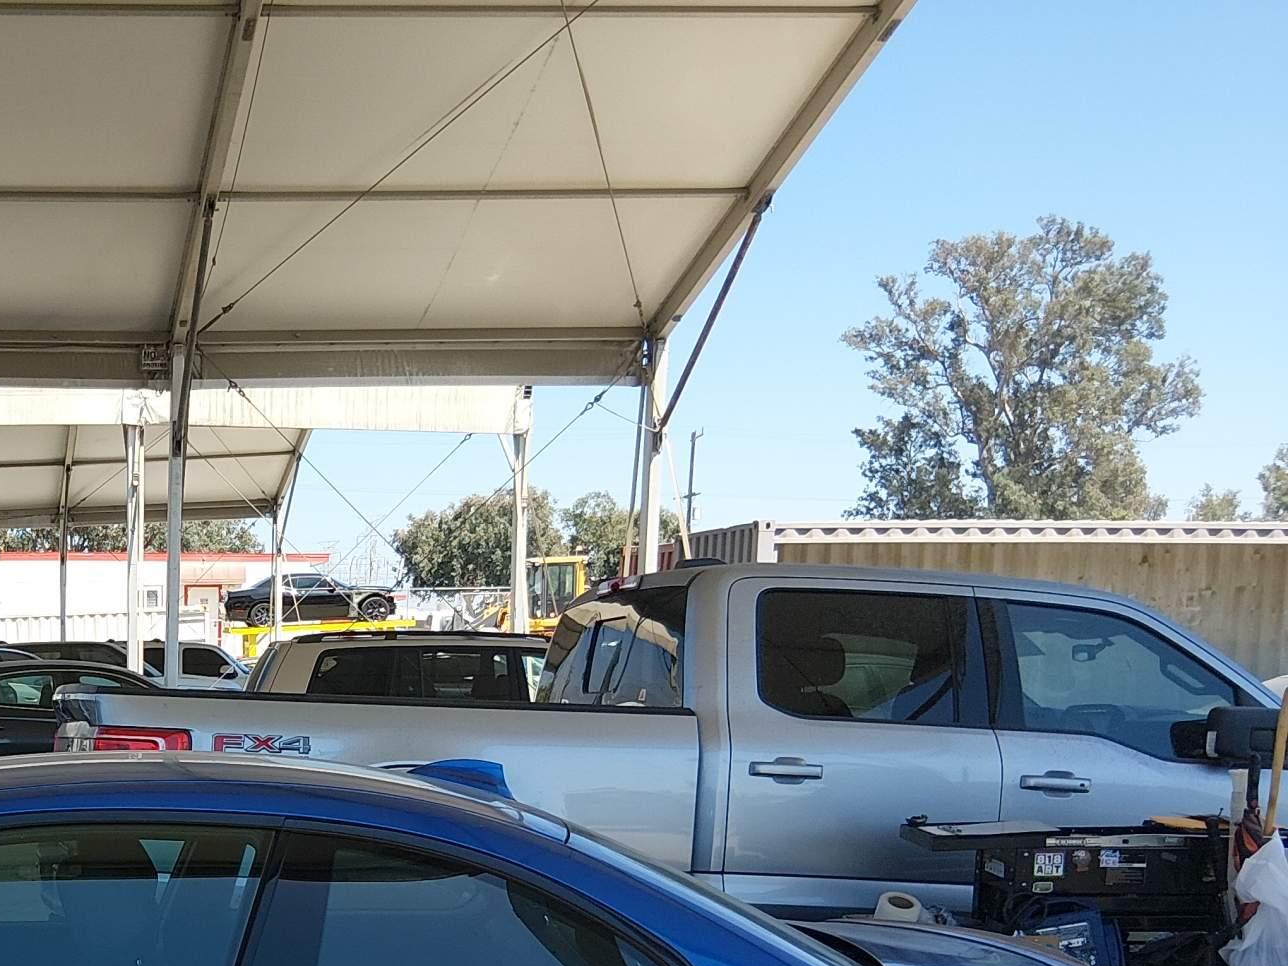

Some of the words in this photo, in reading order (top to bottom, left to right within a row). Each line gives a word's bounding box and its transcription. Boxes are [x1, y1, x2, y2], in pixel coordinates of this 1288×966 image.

[212, 733, 312, 754] FX4
[1036, 855, 1062, 864] 818
[1035, 864, 1062, 874] ART
